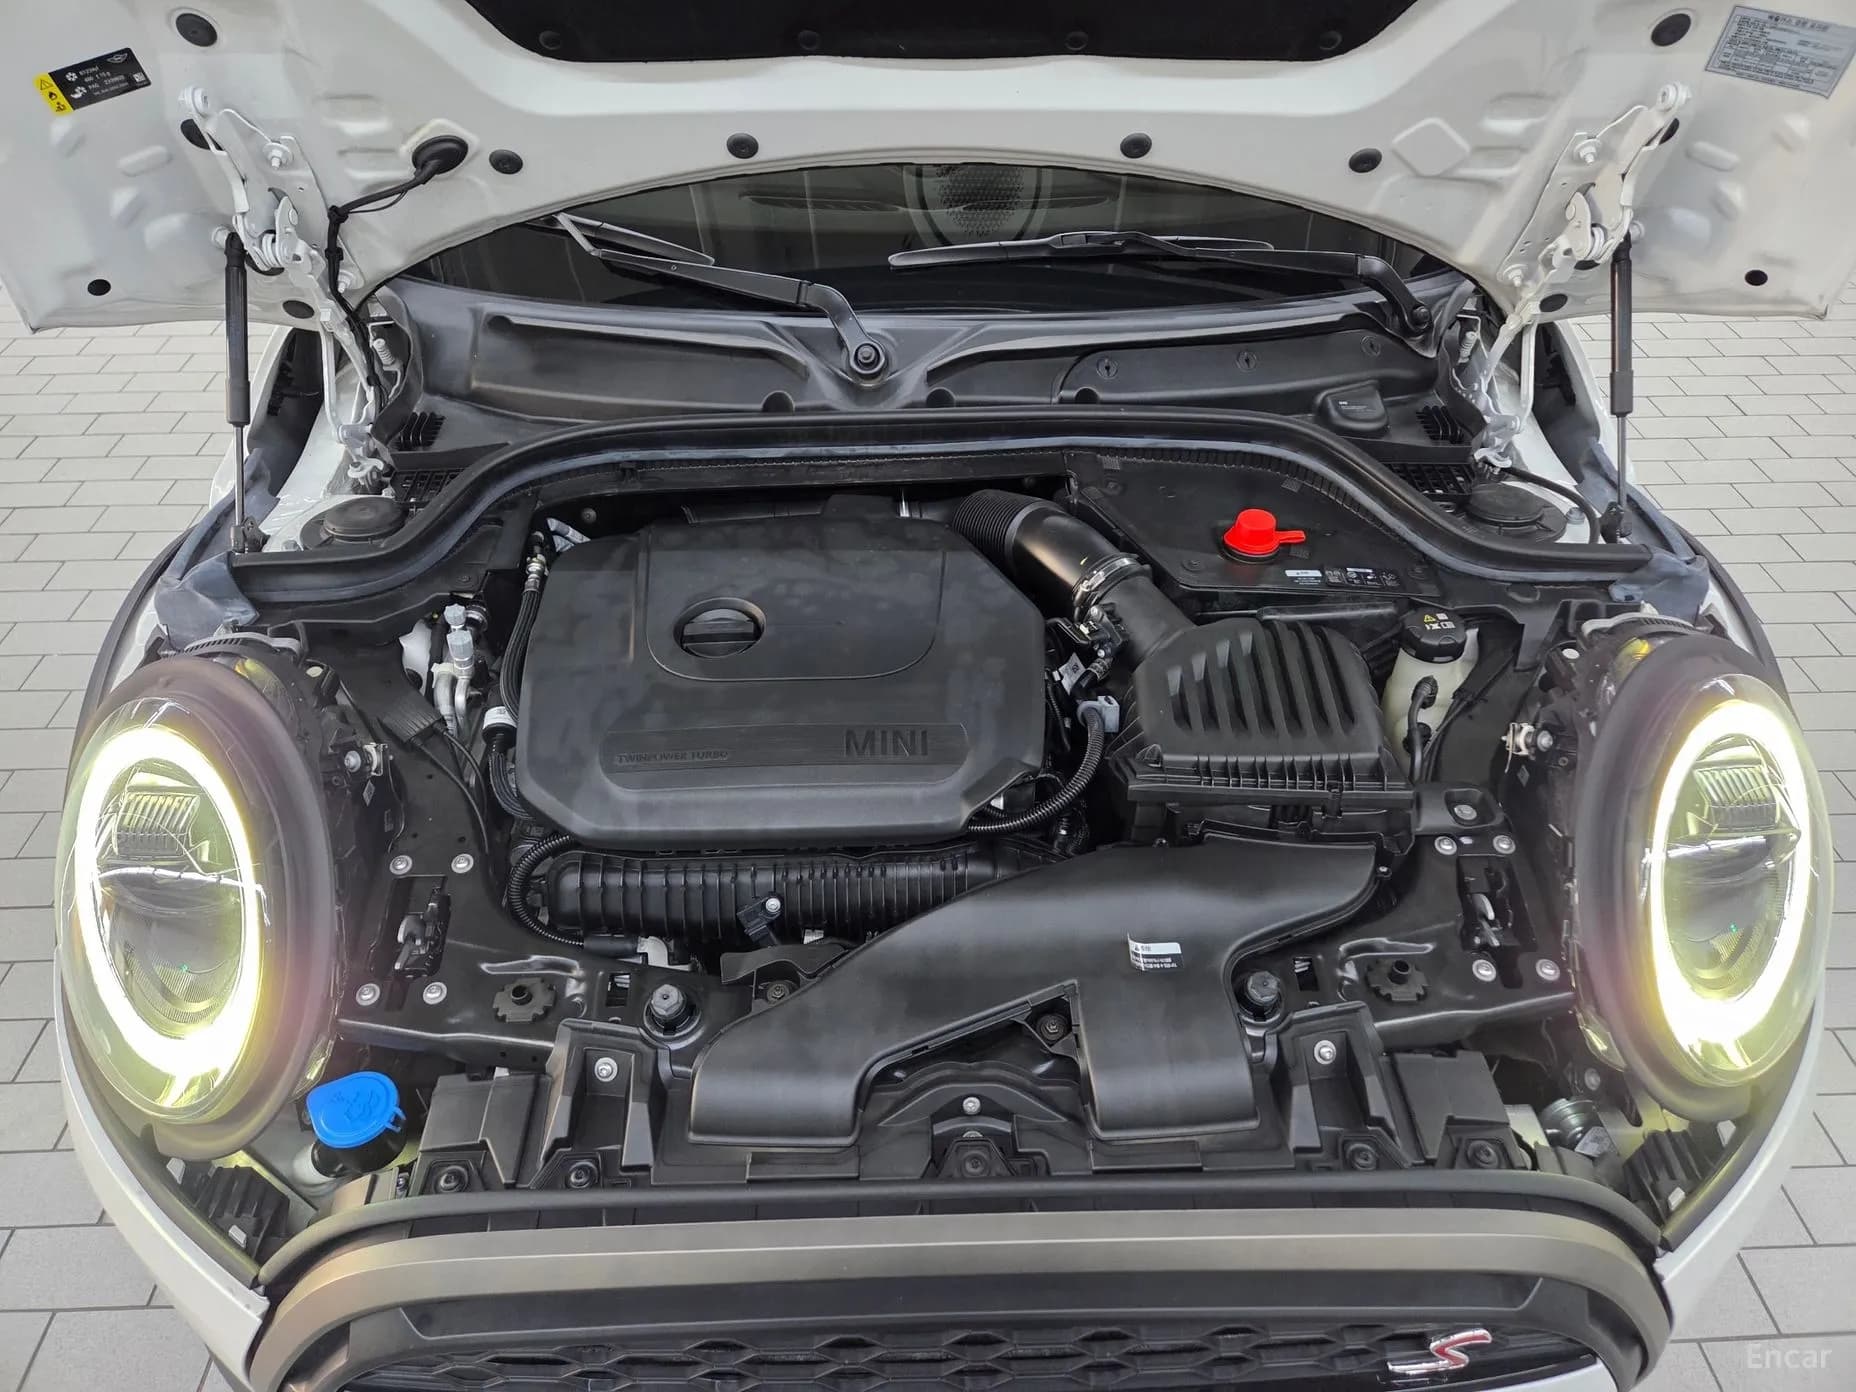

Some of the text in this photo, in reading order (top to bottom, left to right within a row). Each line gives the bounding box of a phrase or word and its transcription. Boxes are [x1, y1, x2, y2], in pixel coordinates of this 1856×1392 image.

[616, 750, 729, 764] TWINOWER TURBO
[845, 729, 928, 757] MINI
[1386, 1328, 1492, 1375] S
